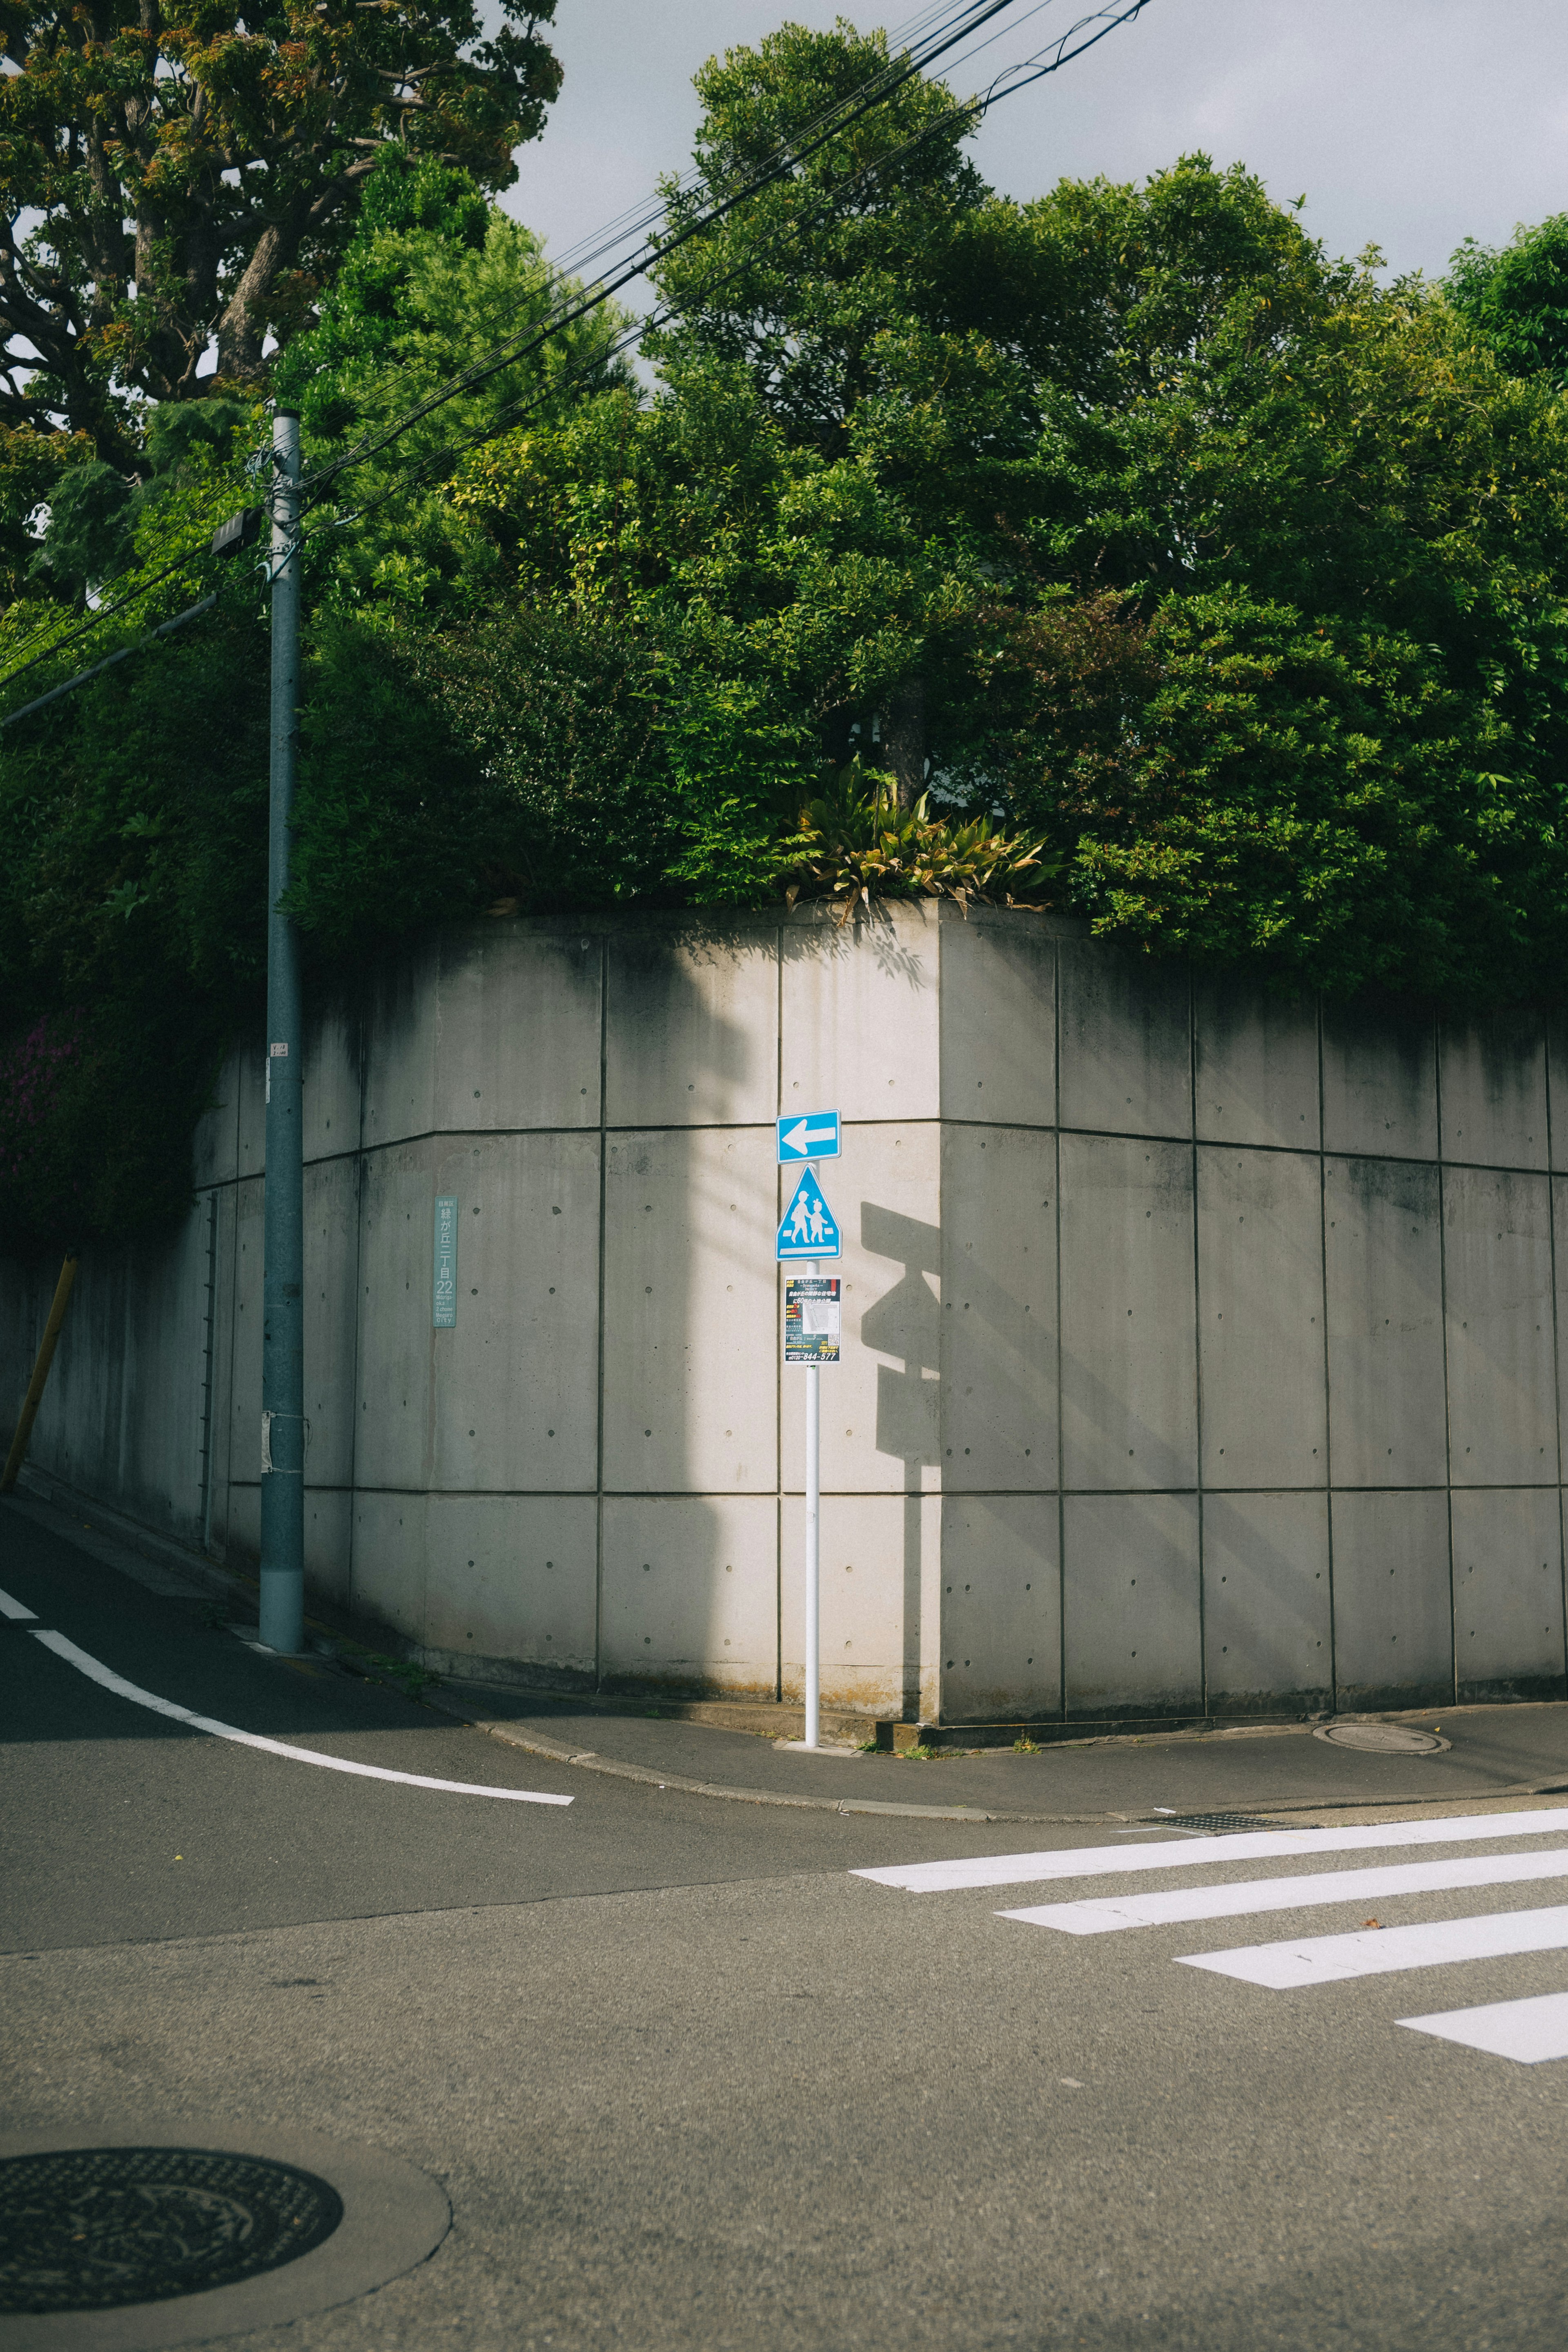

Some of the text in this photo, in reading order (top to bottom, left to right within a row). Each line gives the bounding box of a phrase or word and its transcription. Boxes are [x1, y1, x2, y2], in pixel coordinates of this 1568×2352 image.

[440, 1208, 451, 1278] 緑が丘二丁目
[437, 1281, 452, 1294] 22
